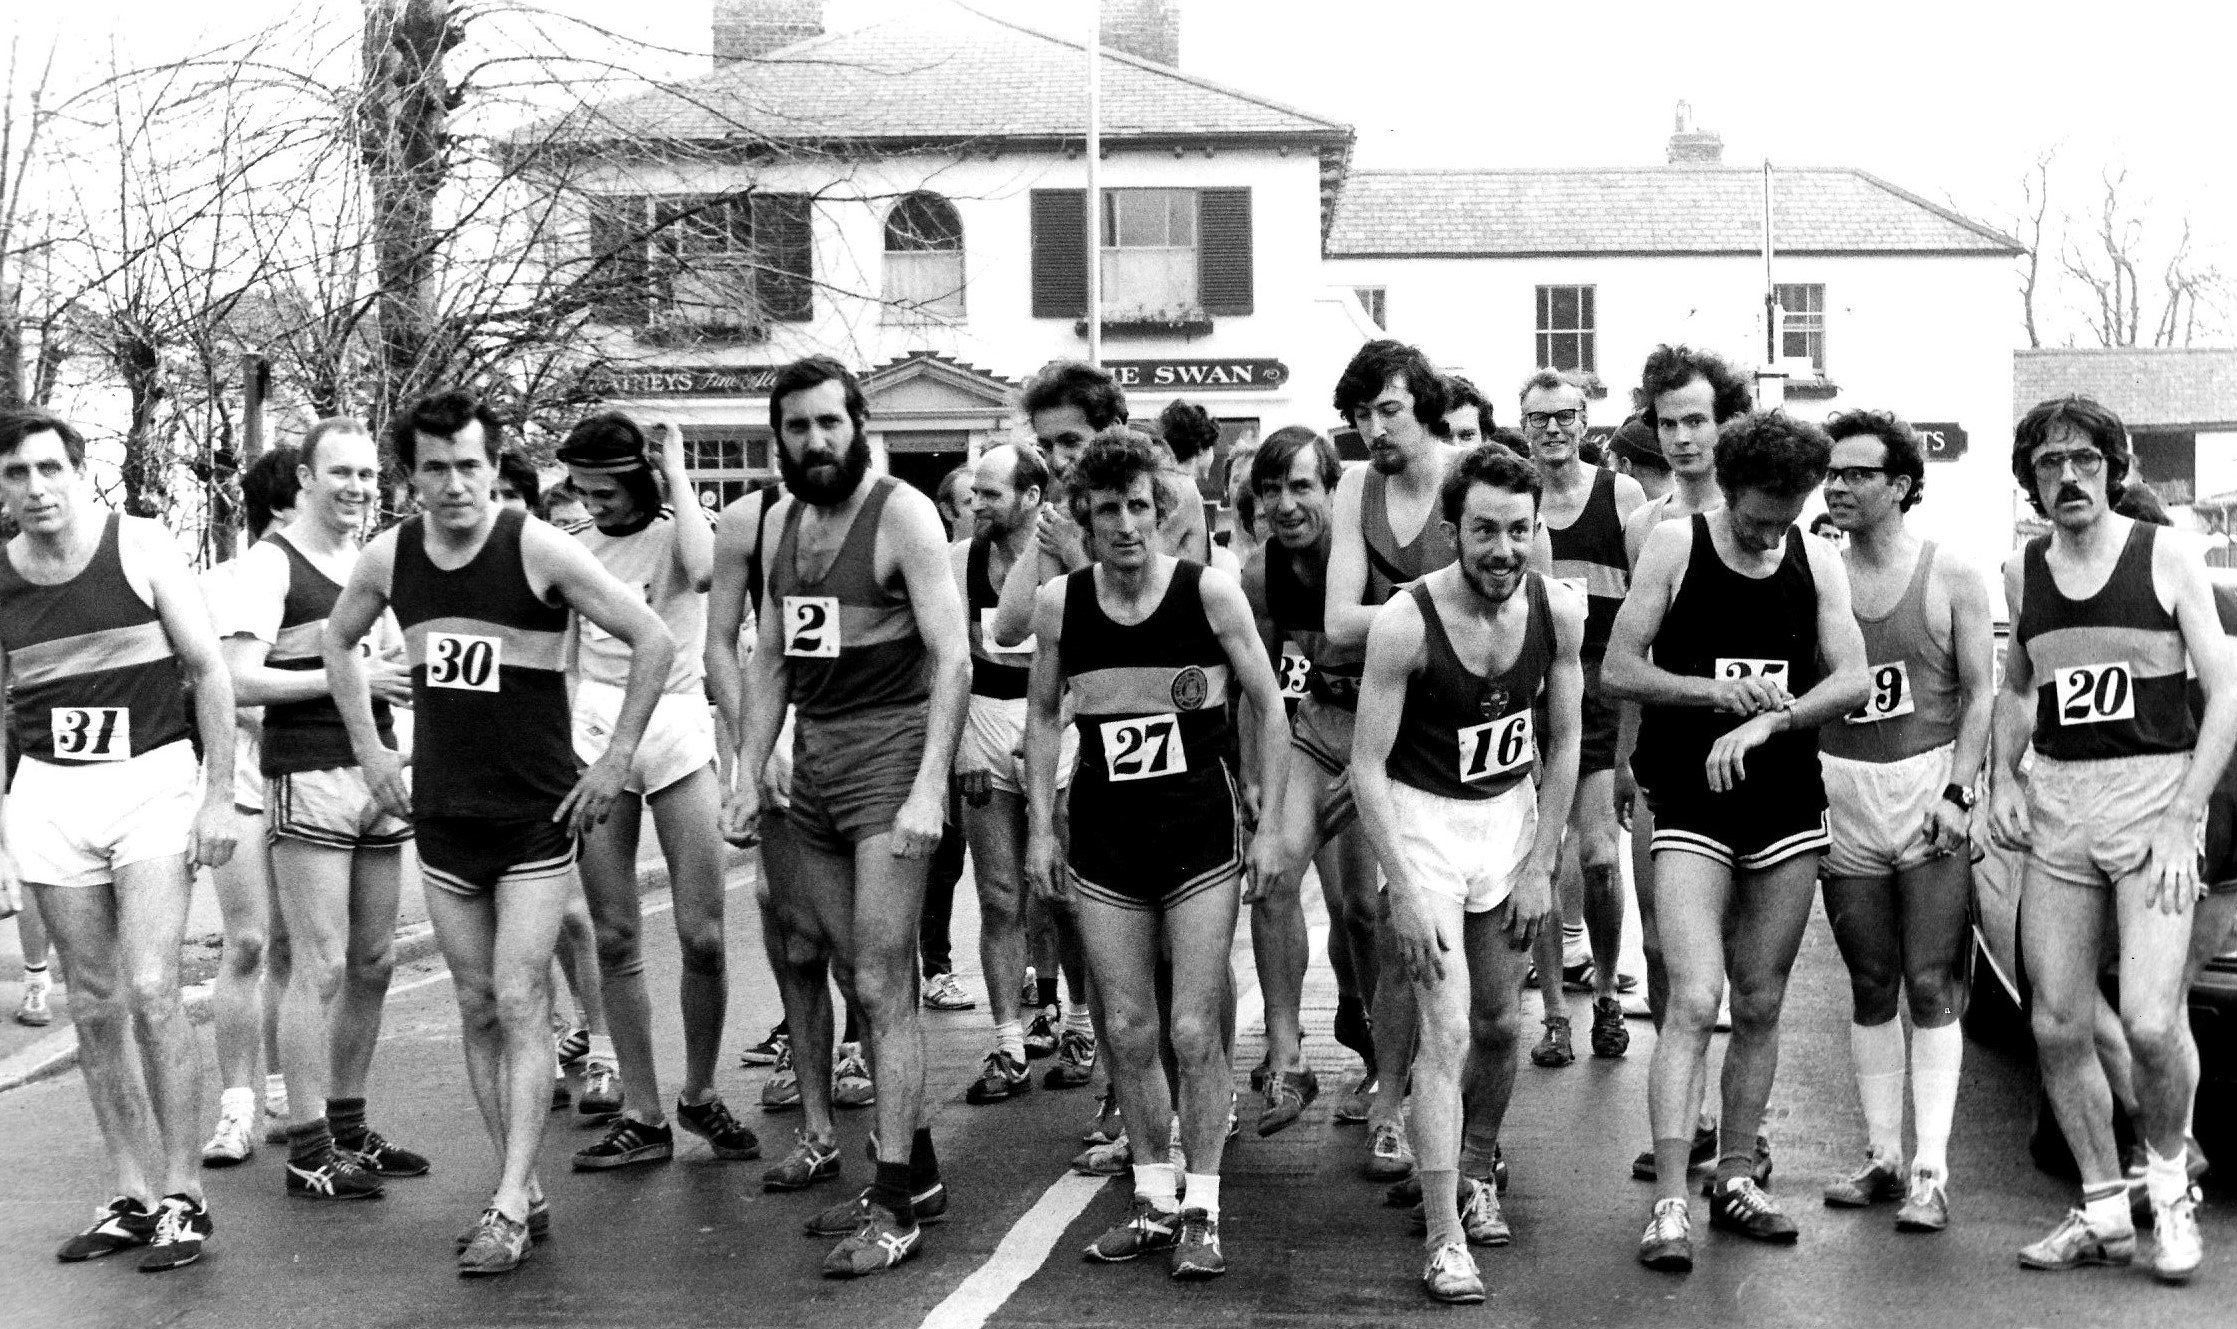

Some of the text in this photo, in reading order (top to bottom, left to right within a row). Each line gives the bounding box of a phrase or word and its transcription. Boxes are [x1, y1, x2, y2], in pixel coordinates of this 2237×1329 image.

[1154, 365, 1254, 385] SWAN
[791, 604, 826, 652] 2
[431, 638, 494, 686] 30
[2064, 666, 2128, 720] 20
[59, 710, 118, 754] 31
[1113, 722, 1175, 776] 27
[1466, 717, 1526, 776] 16
